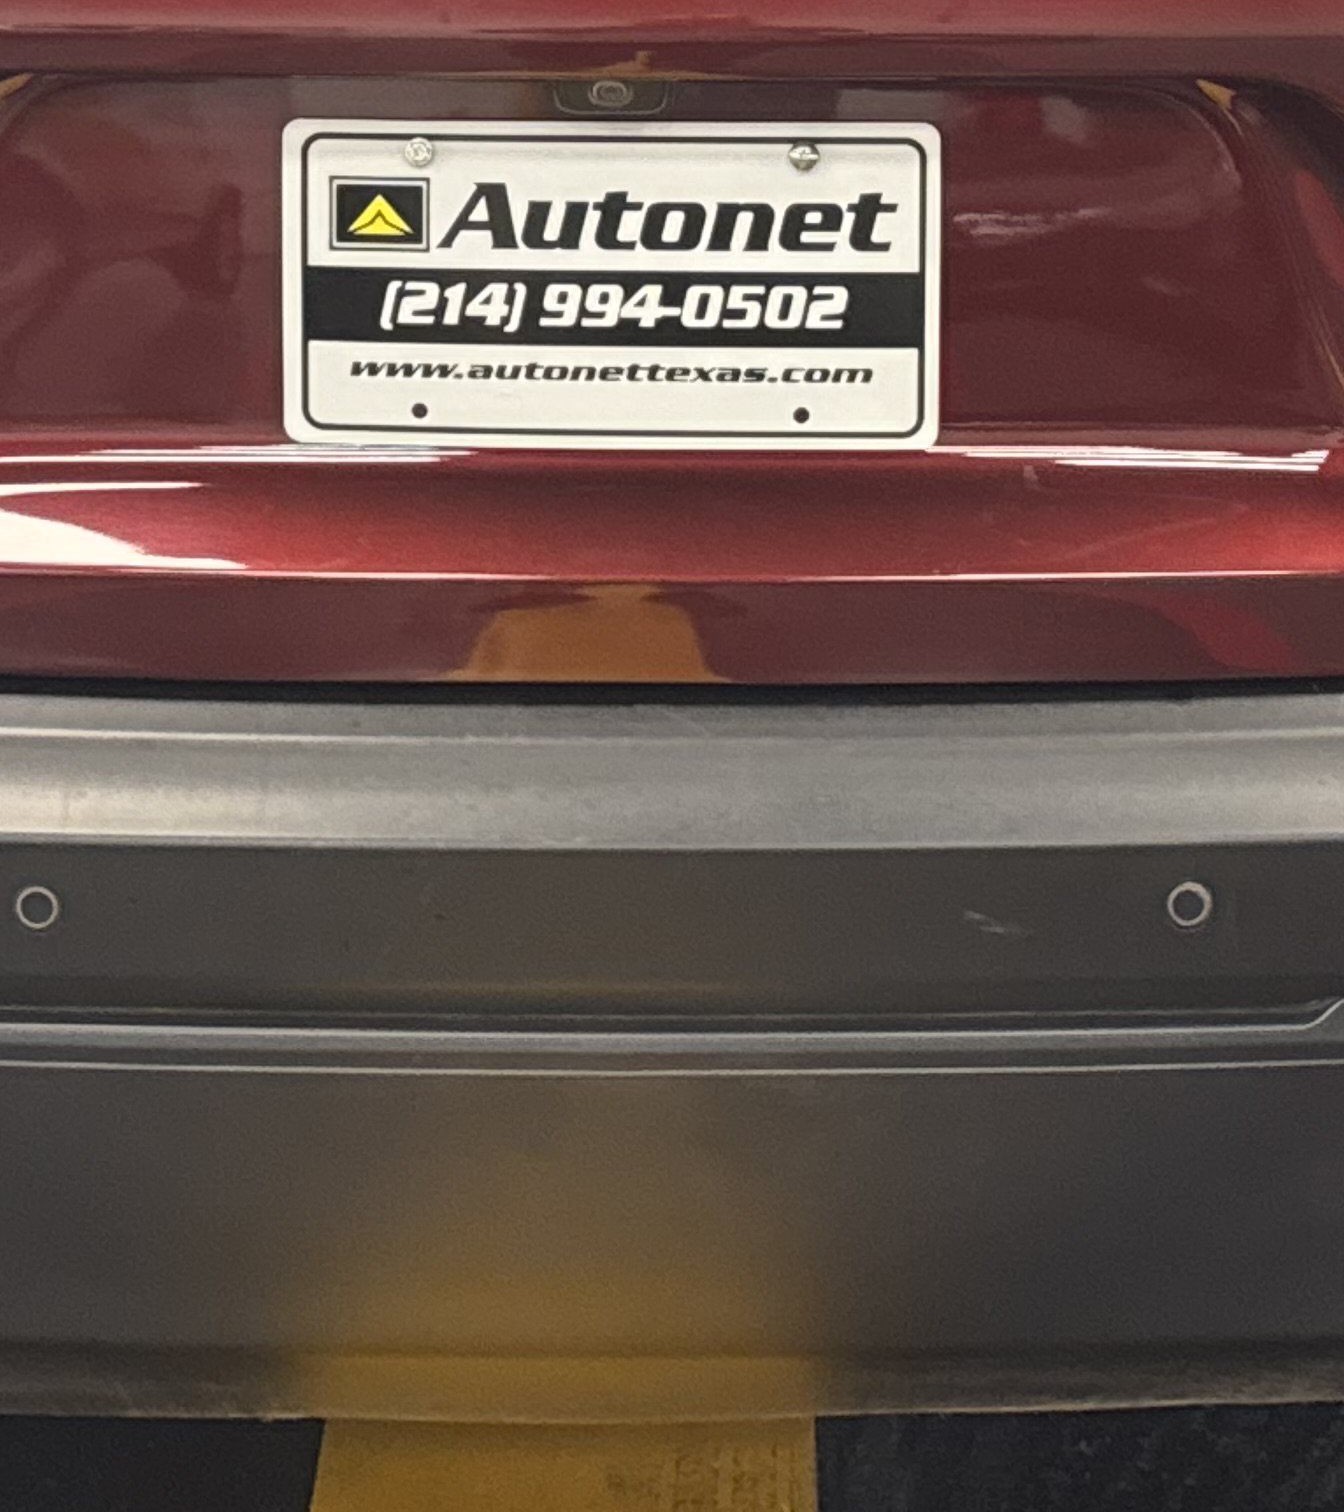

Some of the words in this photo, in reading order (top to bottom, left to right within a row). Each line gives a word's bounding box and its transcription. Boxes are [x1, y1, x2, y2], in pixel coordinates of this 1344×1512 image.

[437, 182, 898, 252] Autonet
[379, 280, 524, 333] (214)
[538, 282, 849, 330] 994-0502
[350, 360, 874, 384] www.autonettexas.com
